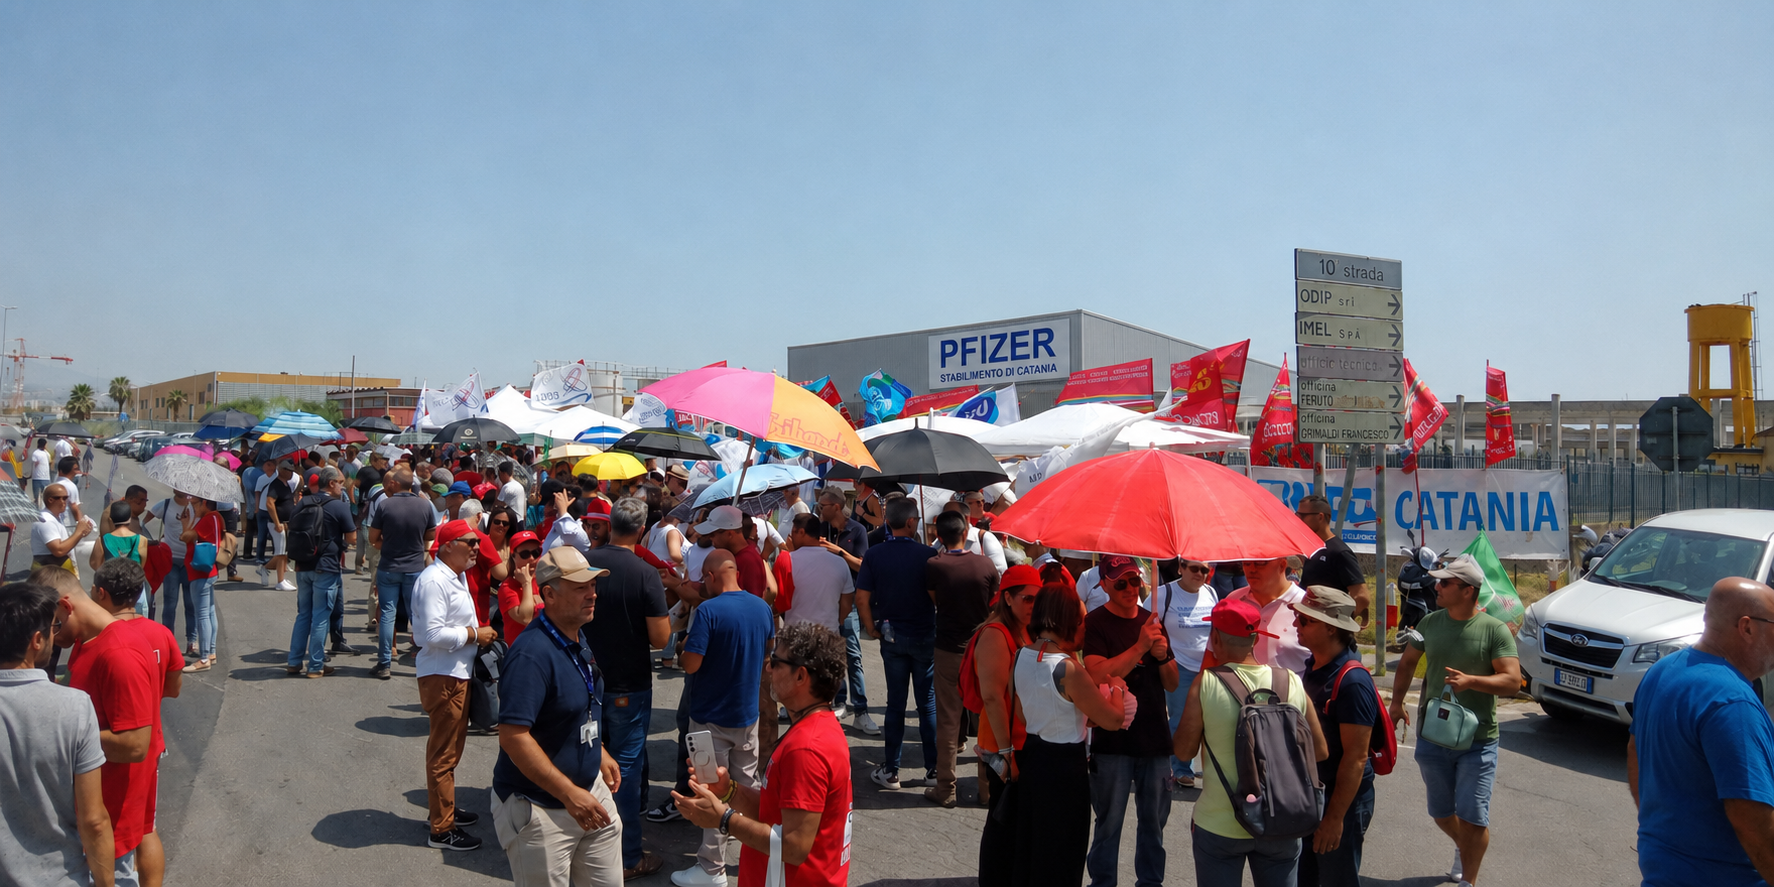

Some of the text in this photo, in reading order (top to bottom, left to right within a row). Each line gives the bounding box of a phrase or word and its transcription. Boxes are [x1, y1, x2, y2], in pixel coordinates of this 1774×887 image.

[1343, 264, 1384, 282] strada
[1300, 288, 1332, 304] ODIP
[1299, 321, 1332, 337] IMEL
[940, 327, 1057, 369] PFIZER
[940, 368, 1003, 383] STABILIMENTO
[1005, 367, 1015, 377] DI
[1017, 363, 1058, 376] CATANIA
[1301, 380, 1336, 392] officina
[1301, 394, 1334, 407] FERUTO
[1301, 413, 1336, 424] officina
[1301, 427, 1340, 439] GRIMALDI
[1342, 428, 1389, 440] FRANCESCO
[1394, 490, 1560, 532] CATANIA
